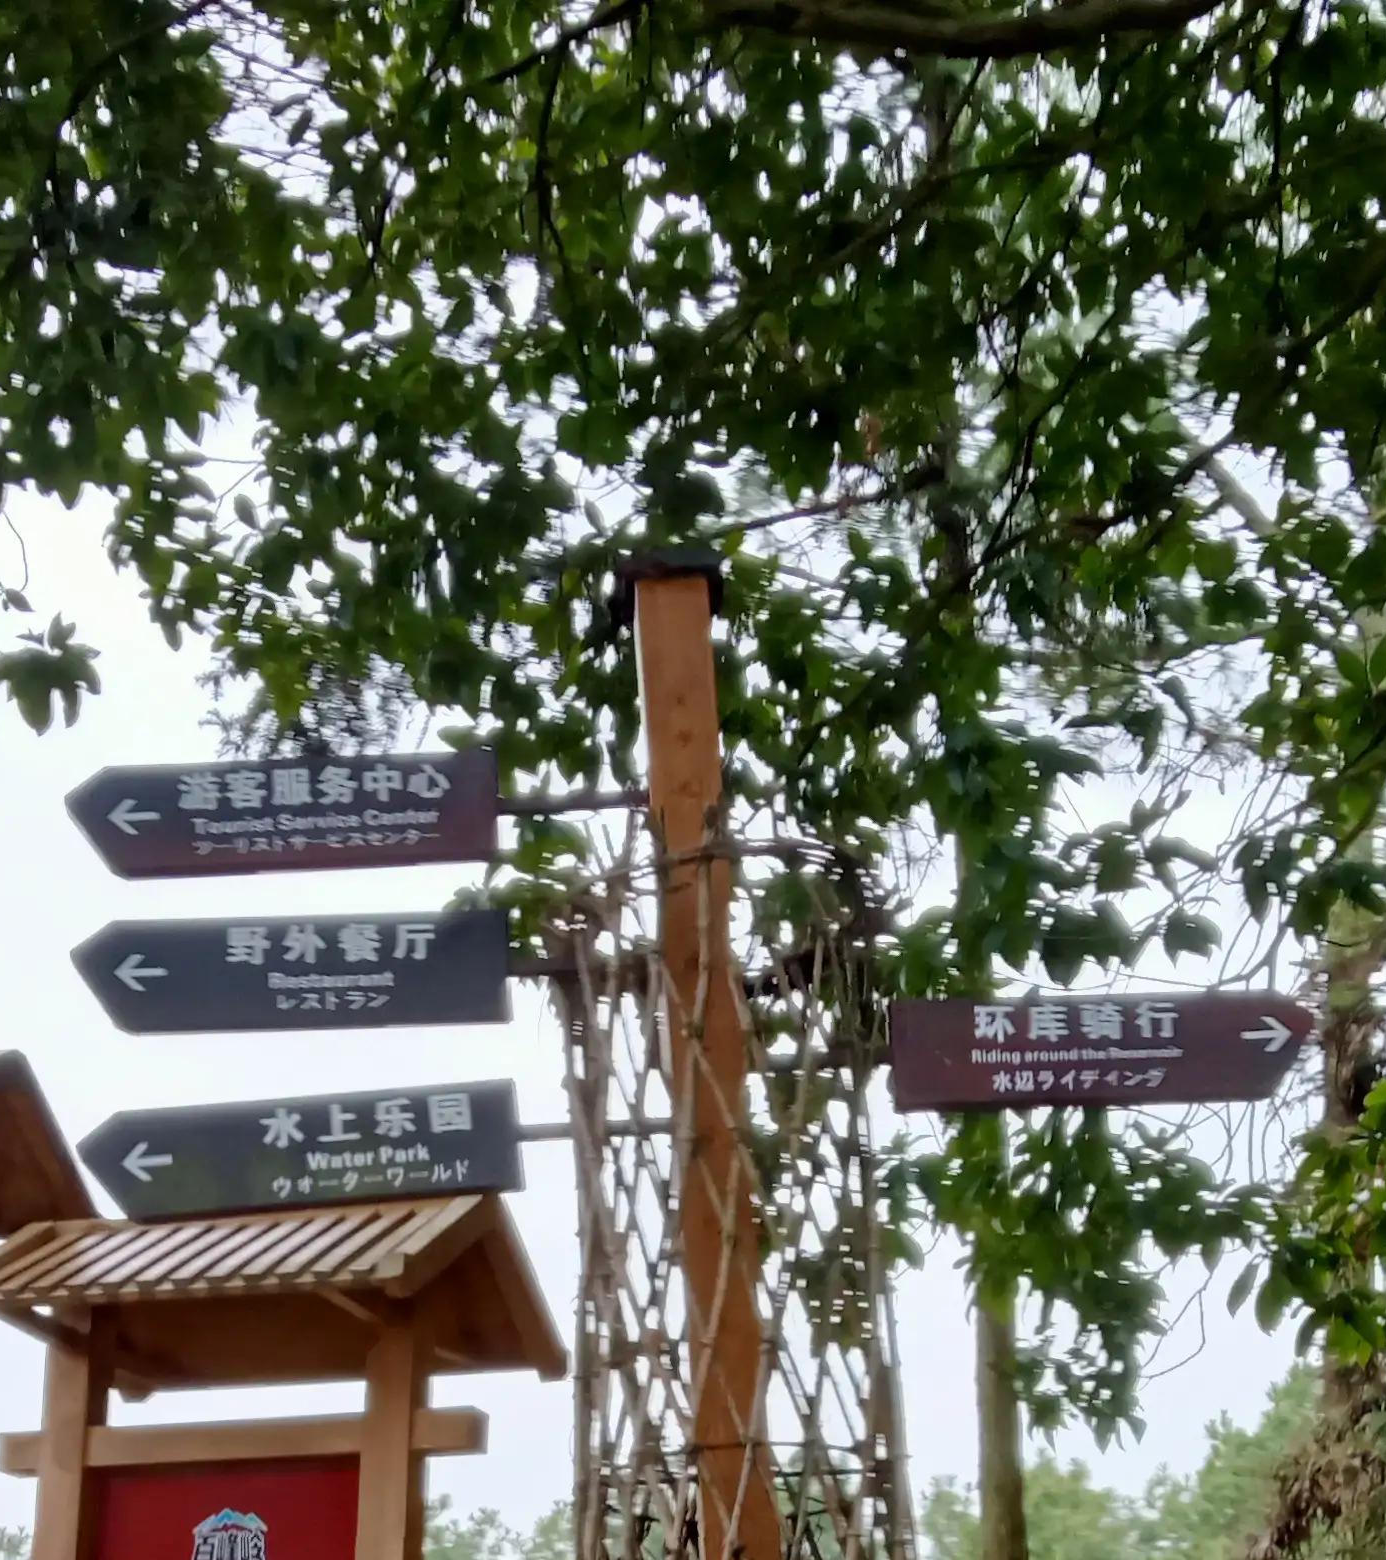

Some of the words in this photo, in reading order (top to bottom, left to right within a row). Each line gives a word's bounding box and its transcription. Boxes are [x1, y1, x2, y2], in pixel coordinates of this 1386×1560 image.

[177, 763, 451, 811] 游客服务中心
[225, 923, 435, 965] 野外餐厅
[276, 991, 390, 1010] レストラン
[973, 1001, 1179, 1044] 环库骑行
[971, 1047, 1021, 1065] Riding
[1024, 1047, 1079, 1064] around
[1081, 1046, 1107, 1061] the
[259, 1092, 473, 1148] 水上乐园
[306, 1150, 375, 1171] Water
[377, 1142, 430, 1165] Park
